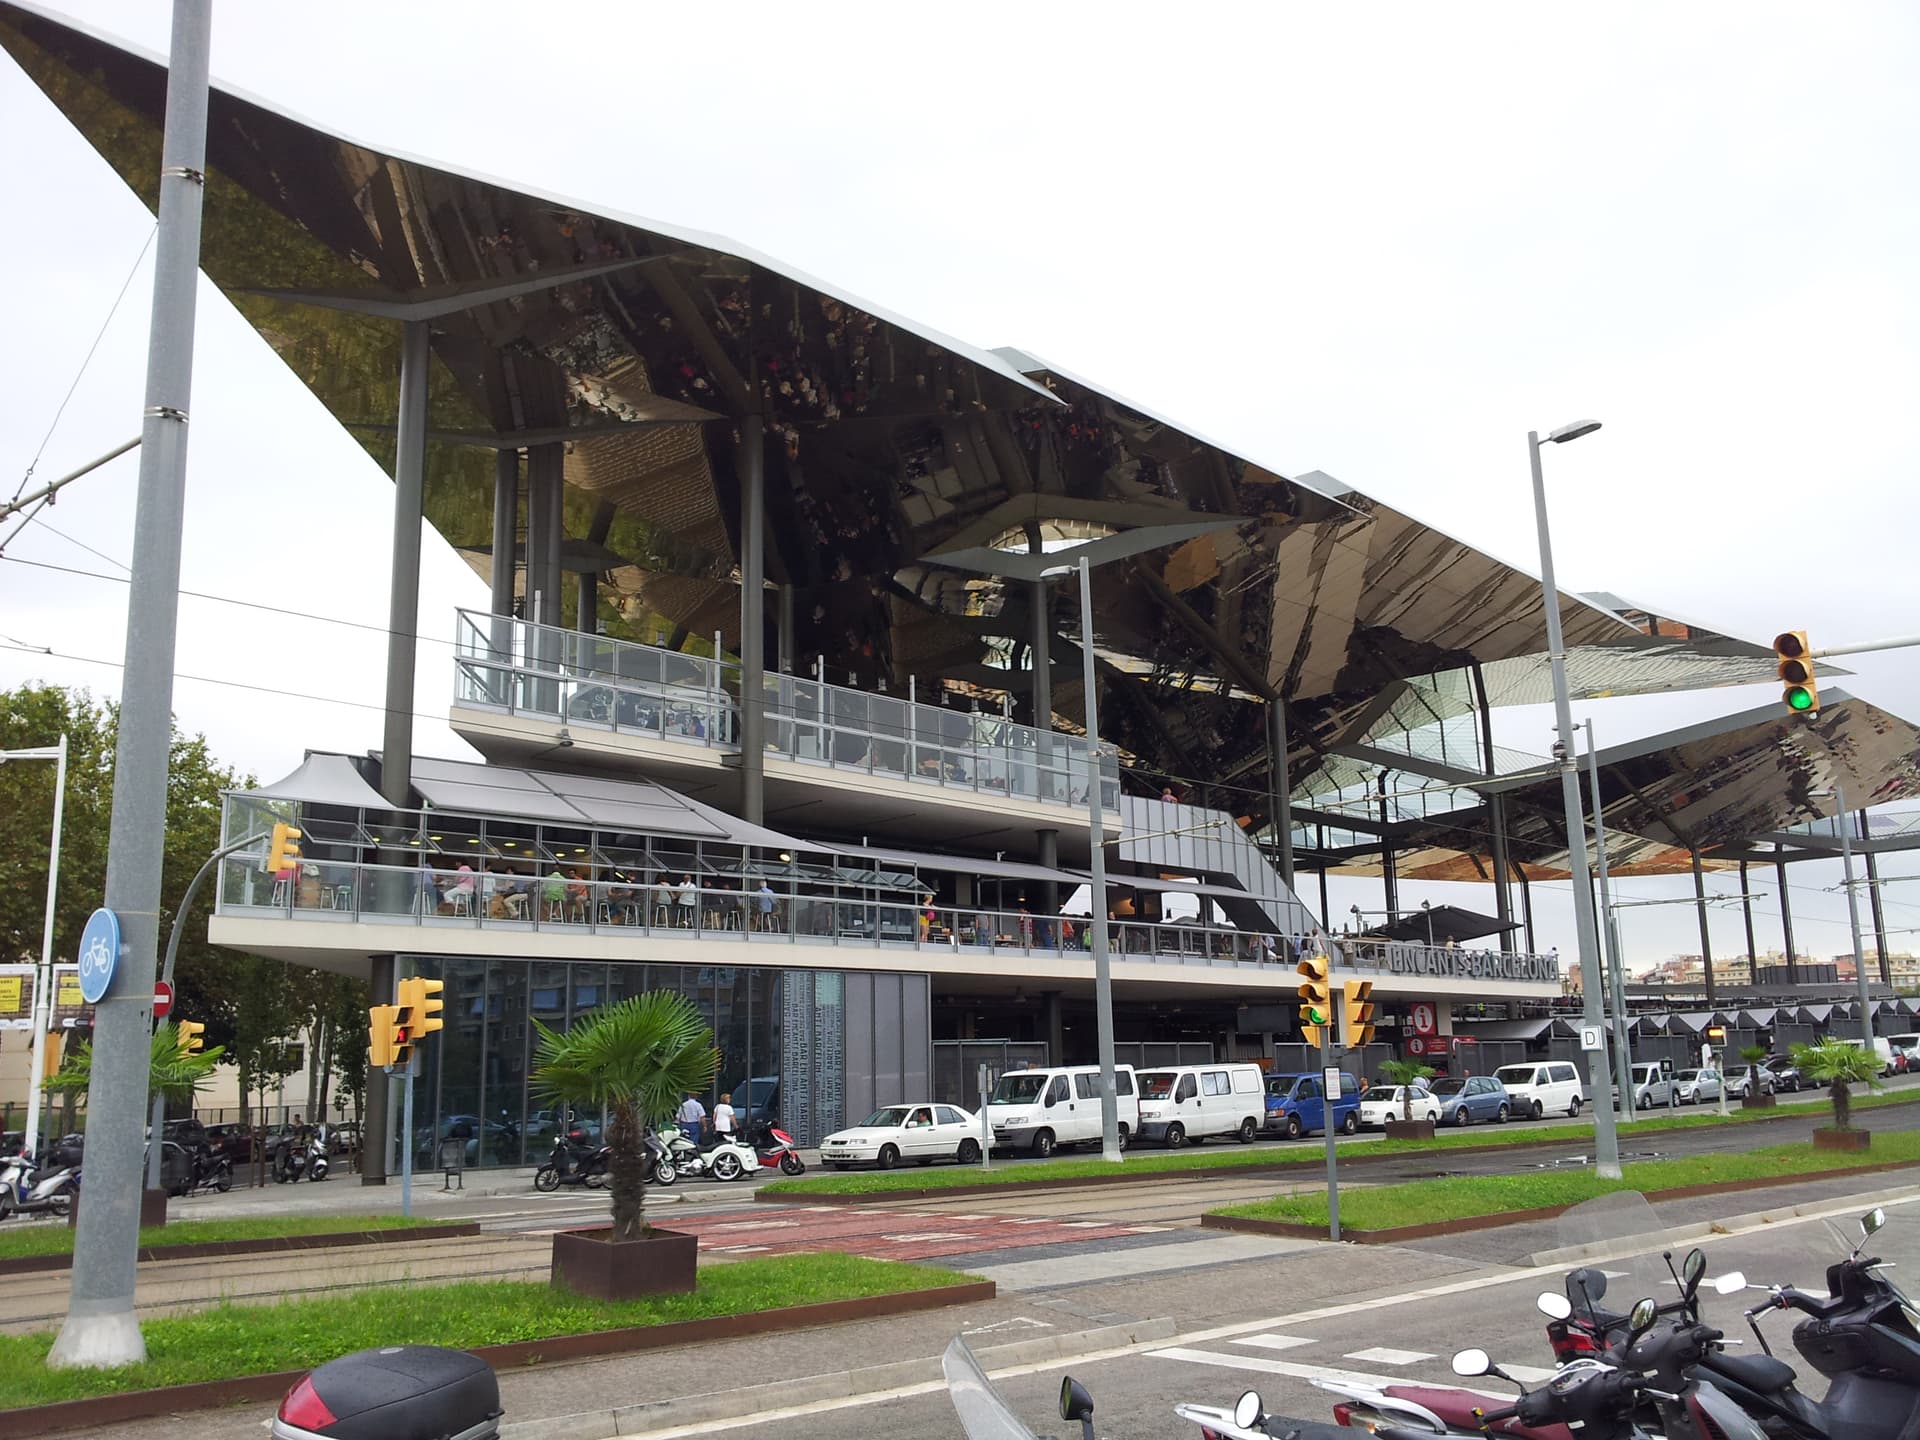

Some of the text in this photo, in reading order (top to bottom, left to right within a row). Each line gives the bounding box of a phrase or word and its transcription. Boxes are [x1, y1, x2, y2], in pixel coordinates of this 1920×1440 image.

[1390, 945, 1558, 980] ENCANTS BARCELONA
[1585, 1031, 1596, 1045] D
